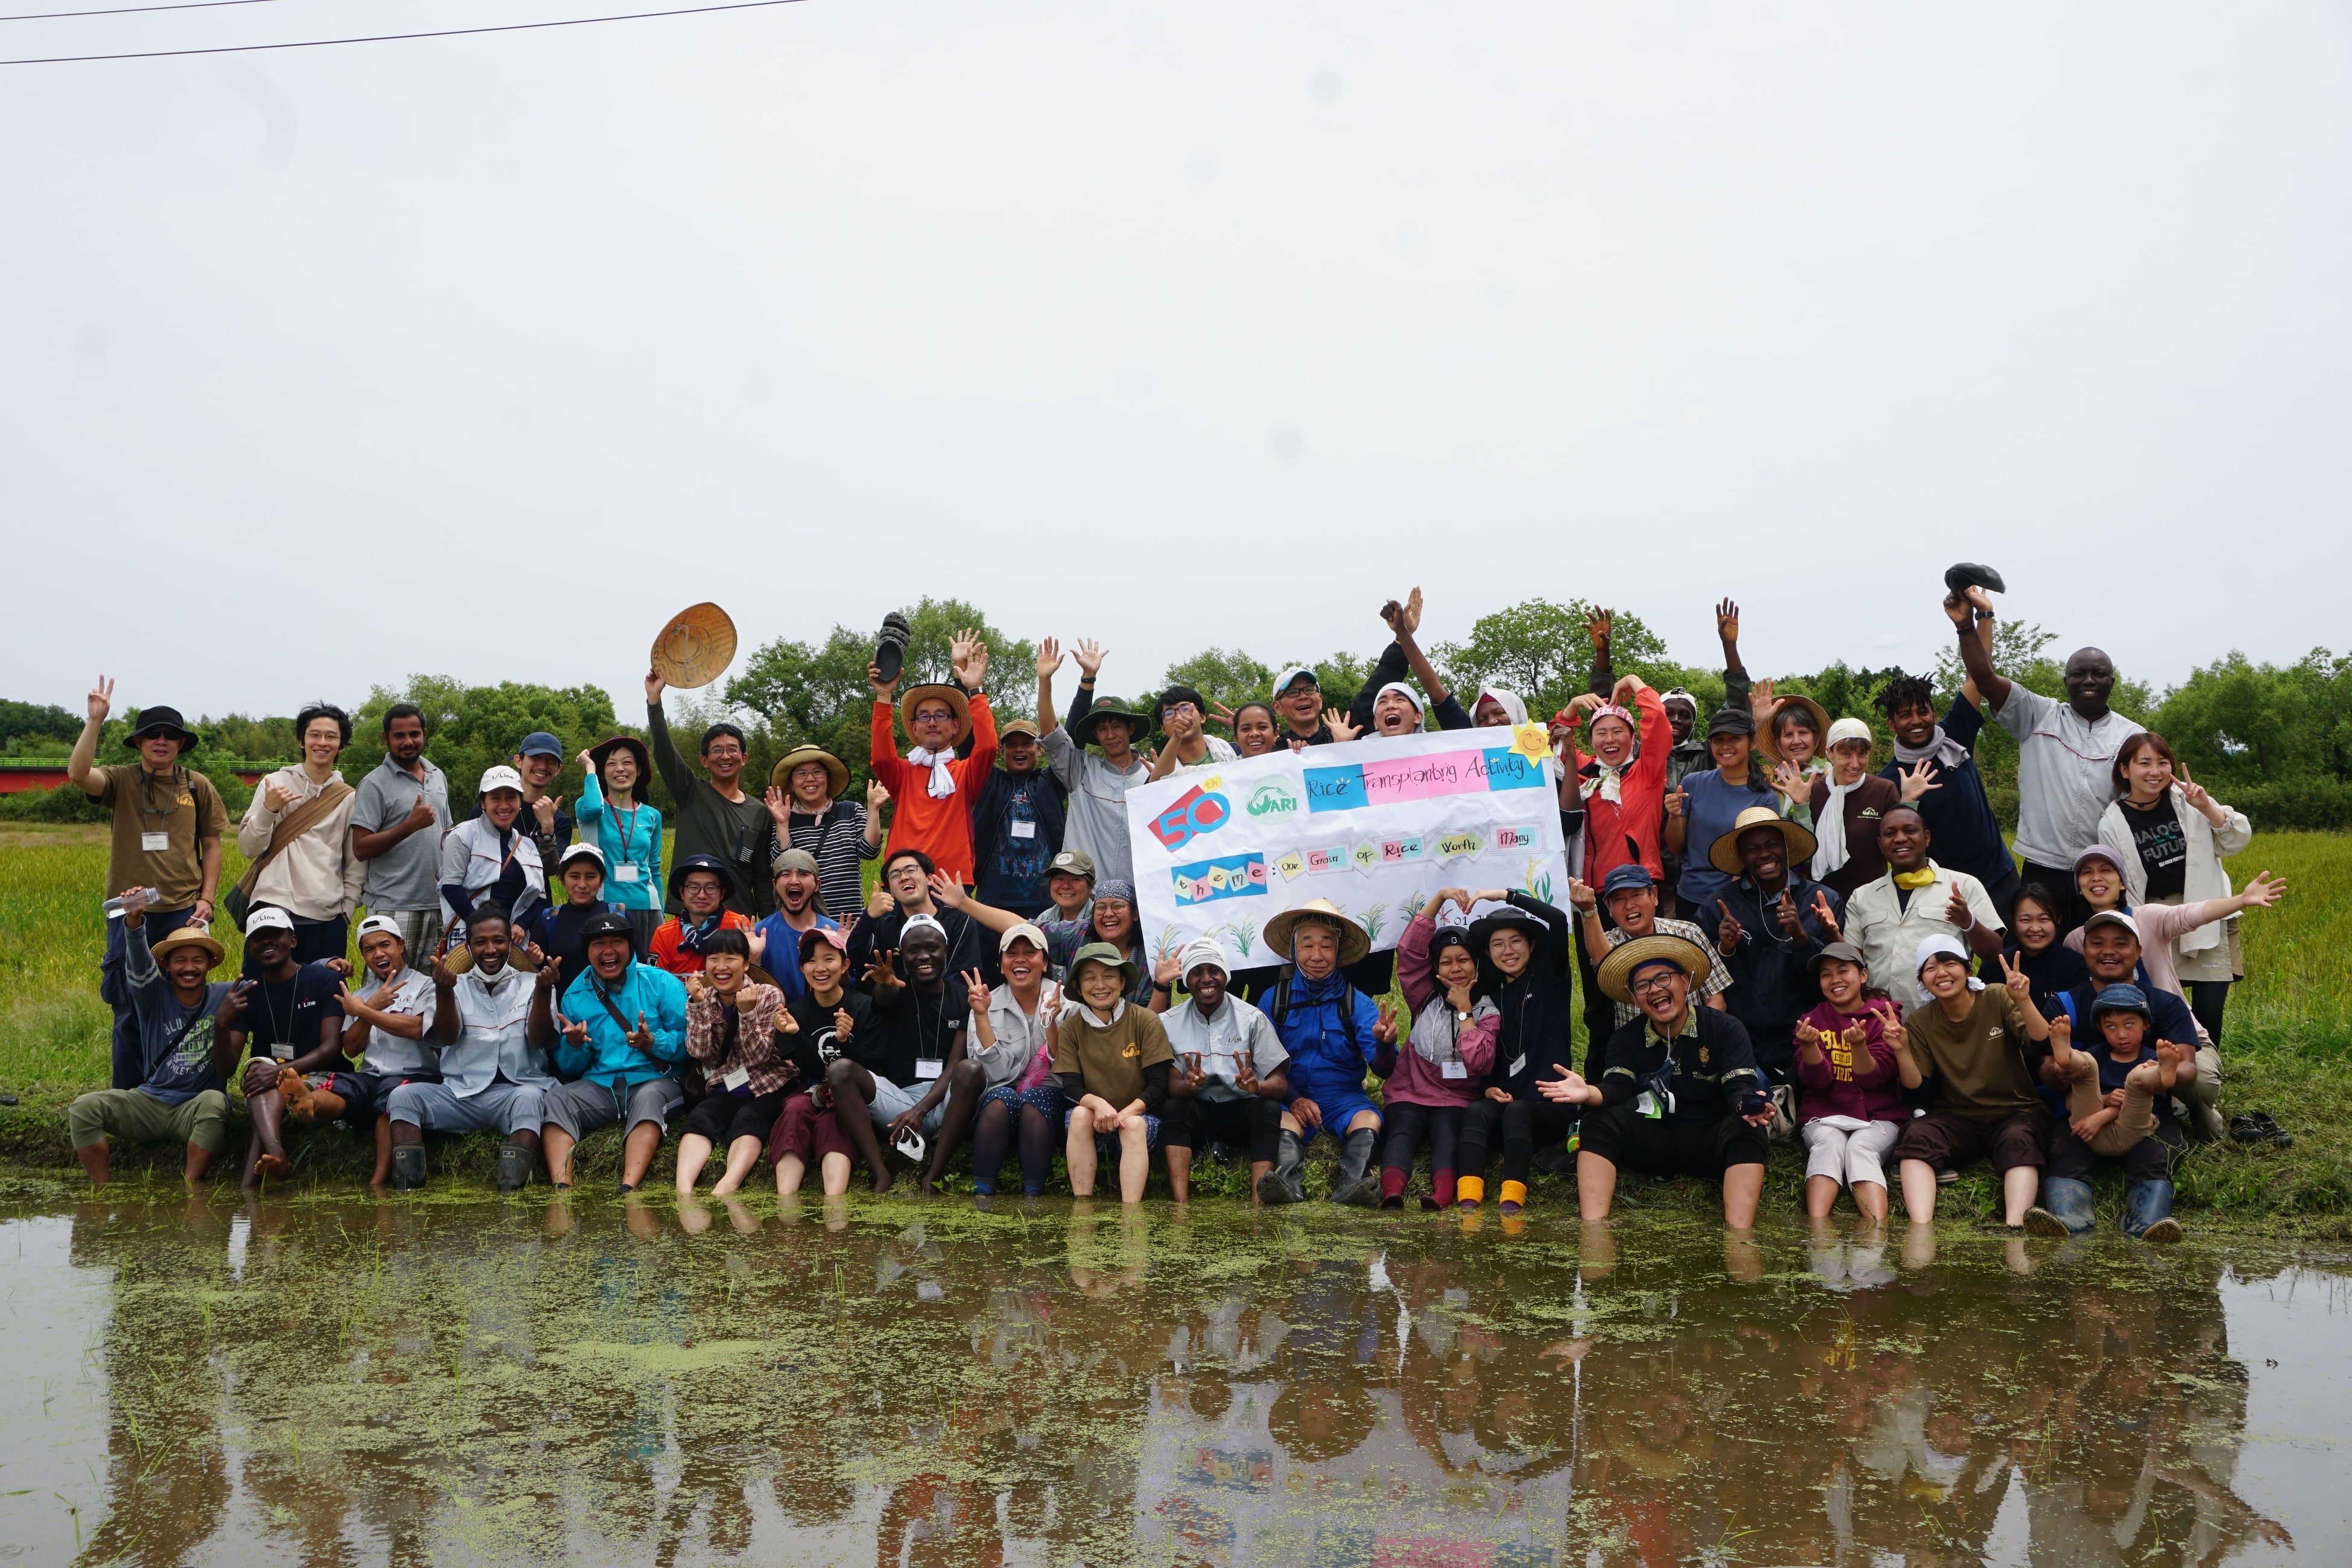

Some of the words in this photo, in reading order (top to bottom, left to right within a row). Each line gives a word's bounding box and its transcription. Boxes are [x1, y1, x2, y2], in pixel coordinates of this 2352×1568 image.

[1307, 780, 1349, 798] Rice
[1356, 763, 1458, 792] Transplanting
[1465, 756, 1524, 780] Activity
[2134, 821, 2181, 844] IALOG
[1310, 854, 1339, 865] Grain
[1385, 844, 1418, 857] Rice
[1441, 839, 1476, 853] Worth
[1500, 832, 1529, 846] Many
[2143, 837, 2187, 862] FUTUR
[1454, 916, 1468, 926] 01
